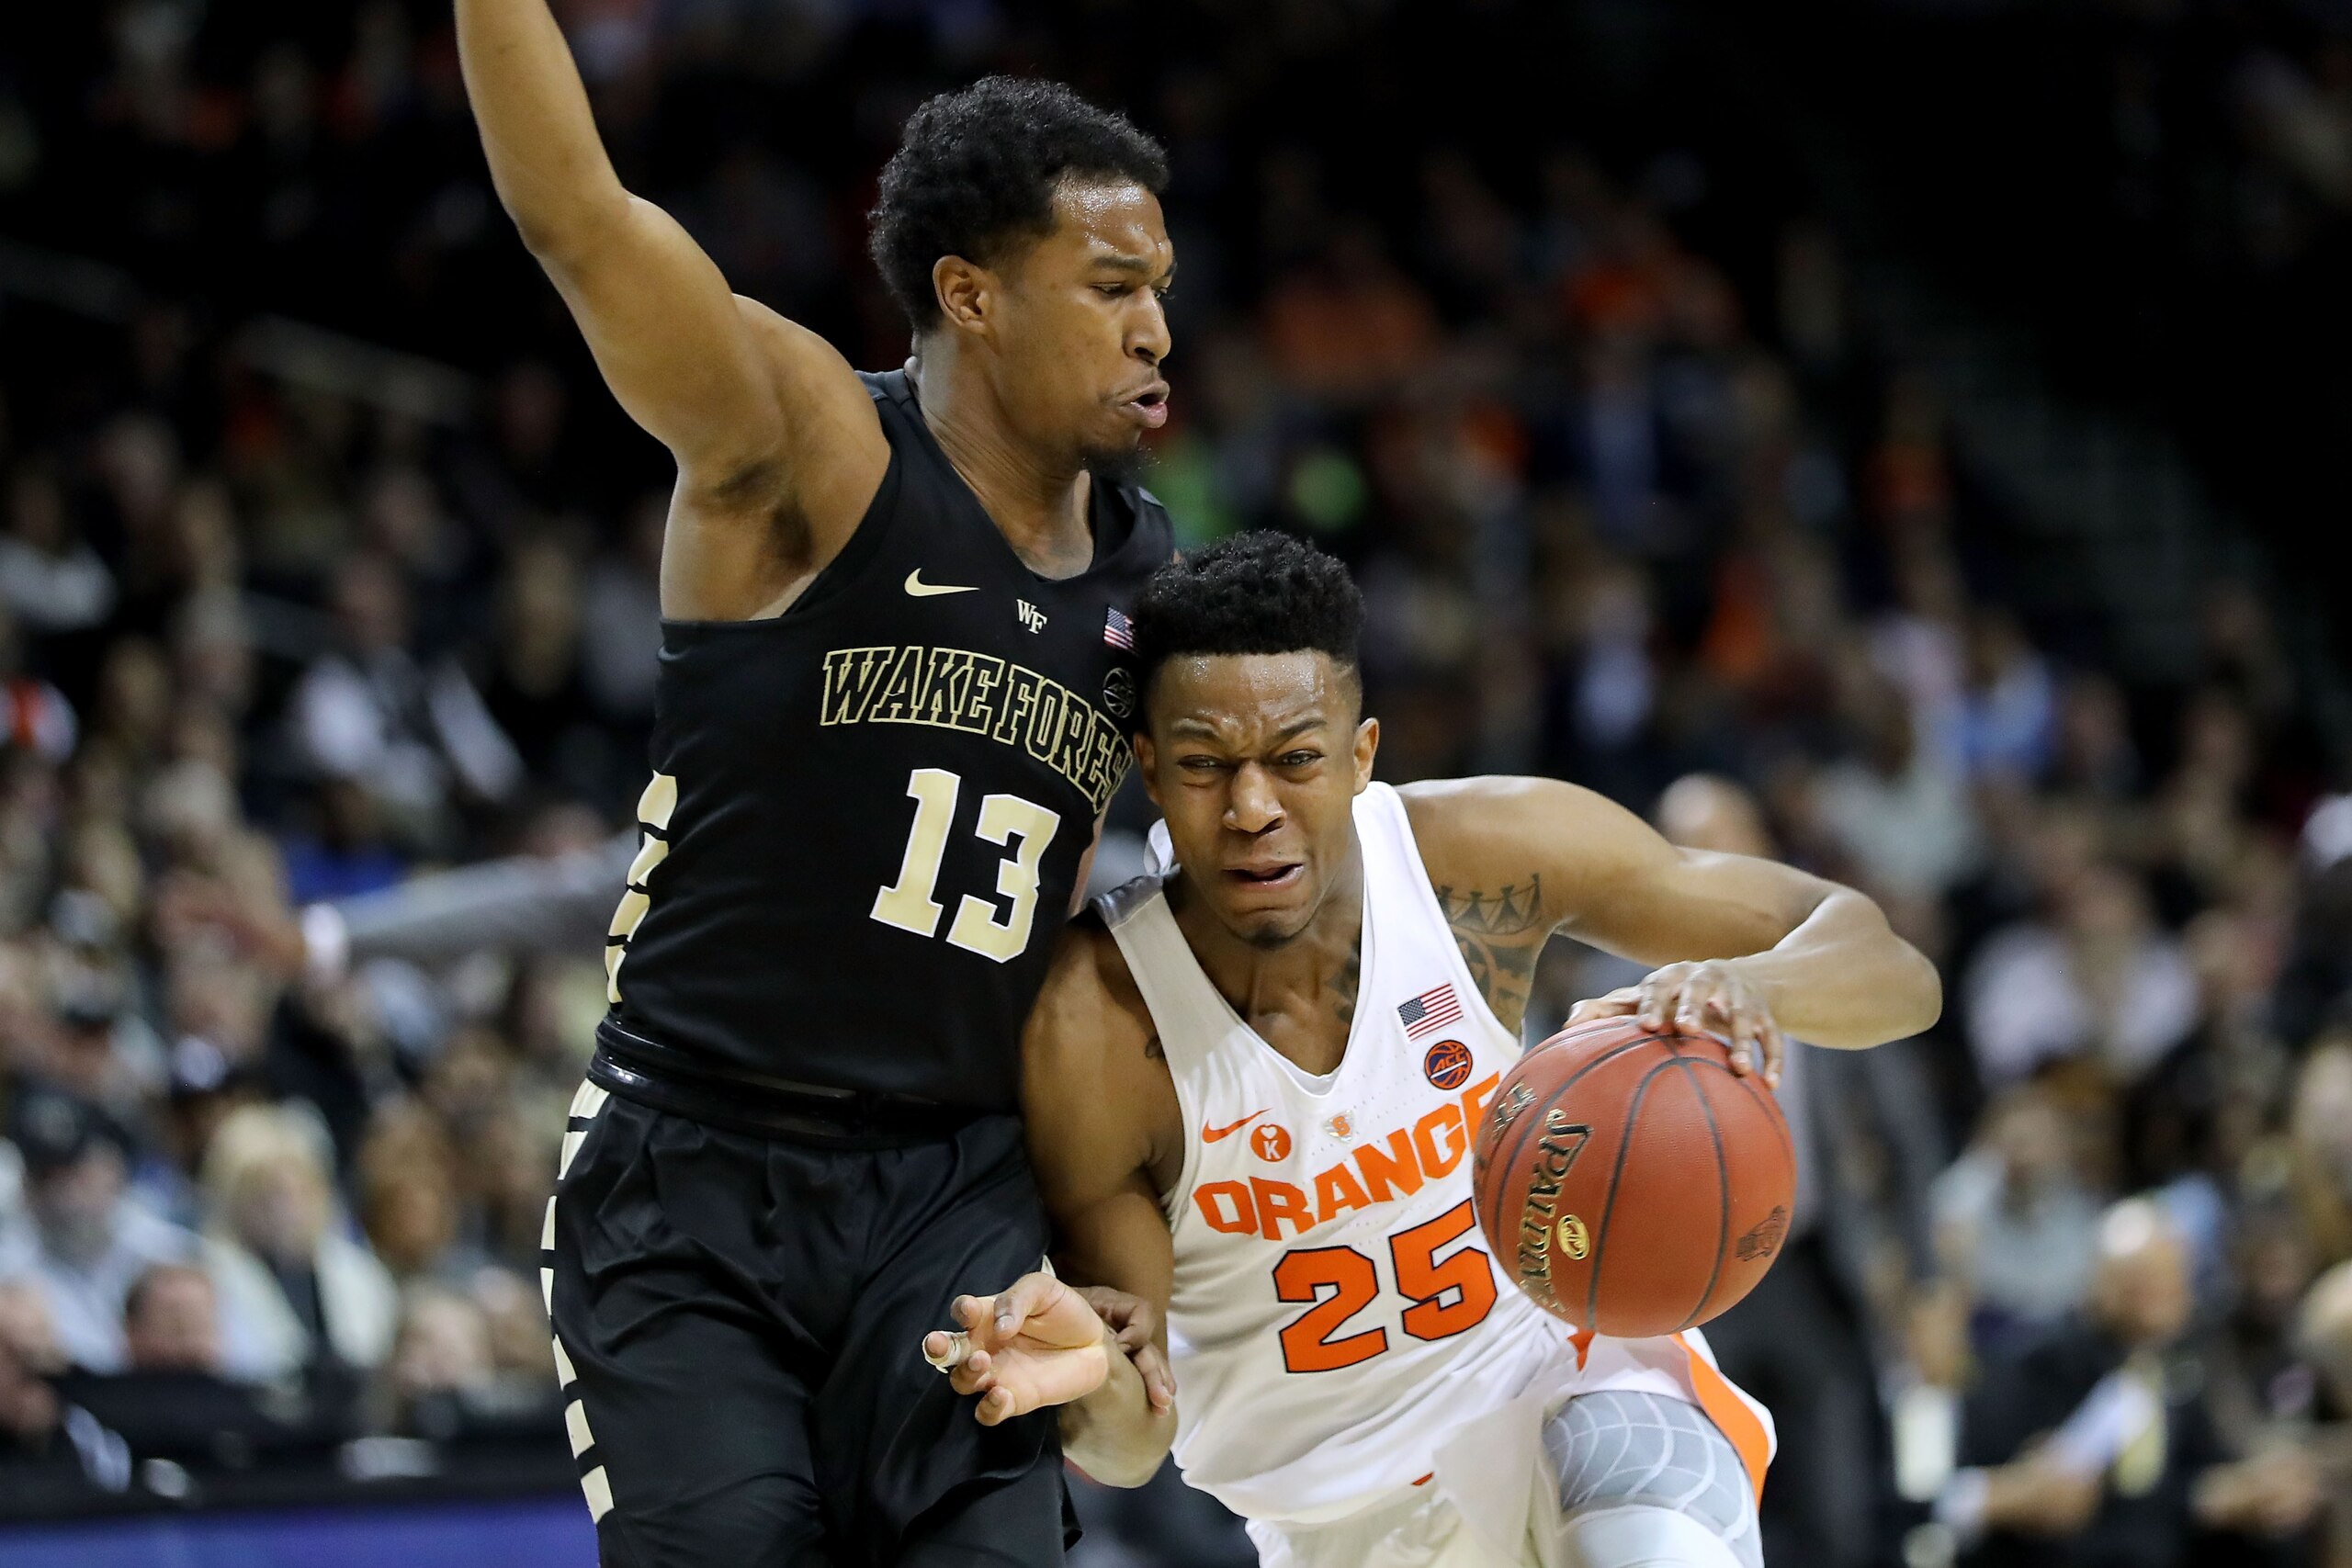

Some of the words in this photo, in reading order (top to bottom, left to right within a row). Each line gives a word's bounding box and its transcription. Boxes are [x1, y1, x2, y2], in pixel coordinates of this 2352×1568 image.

[1016, 598, 1048, 634] WF
[820, 646, 1005, 734] WAKE
[992, 664, 1134, 814] FORES
[869, 768, 1061, 963] 13
[1433, 1050, 1467, 1073] ACC
[1263, 1140, 1282, 1159] K
[1516, 1109, 1594, 1314] SPALDIN
[1272, 1196, 1498, 1373] 25
